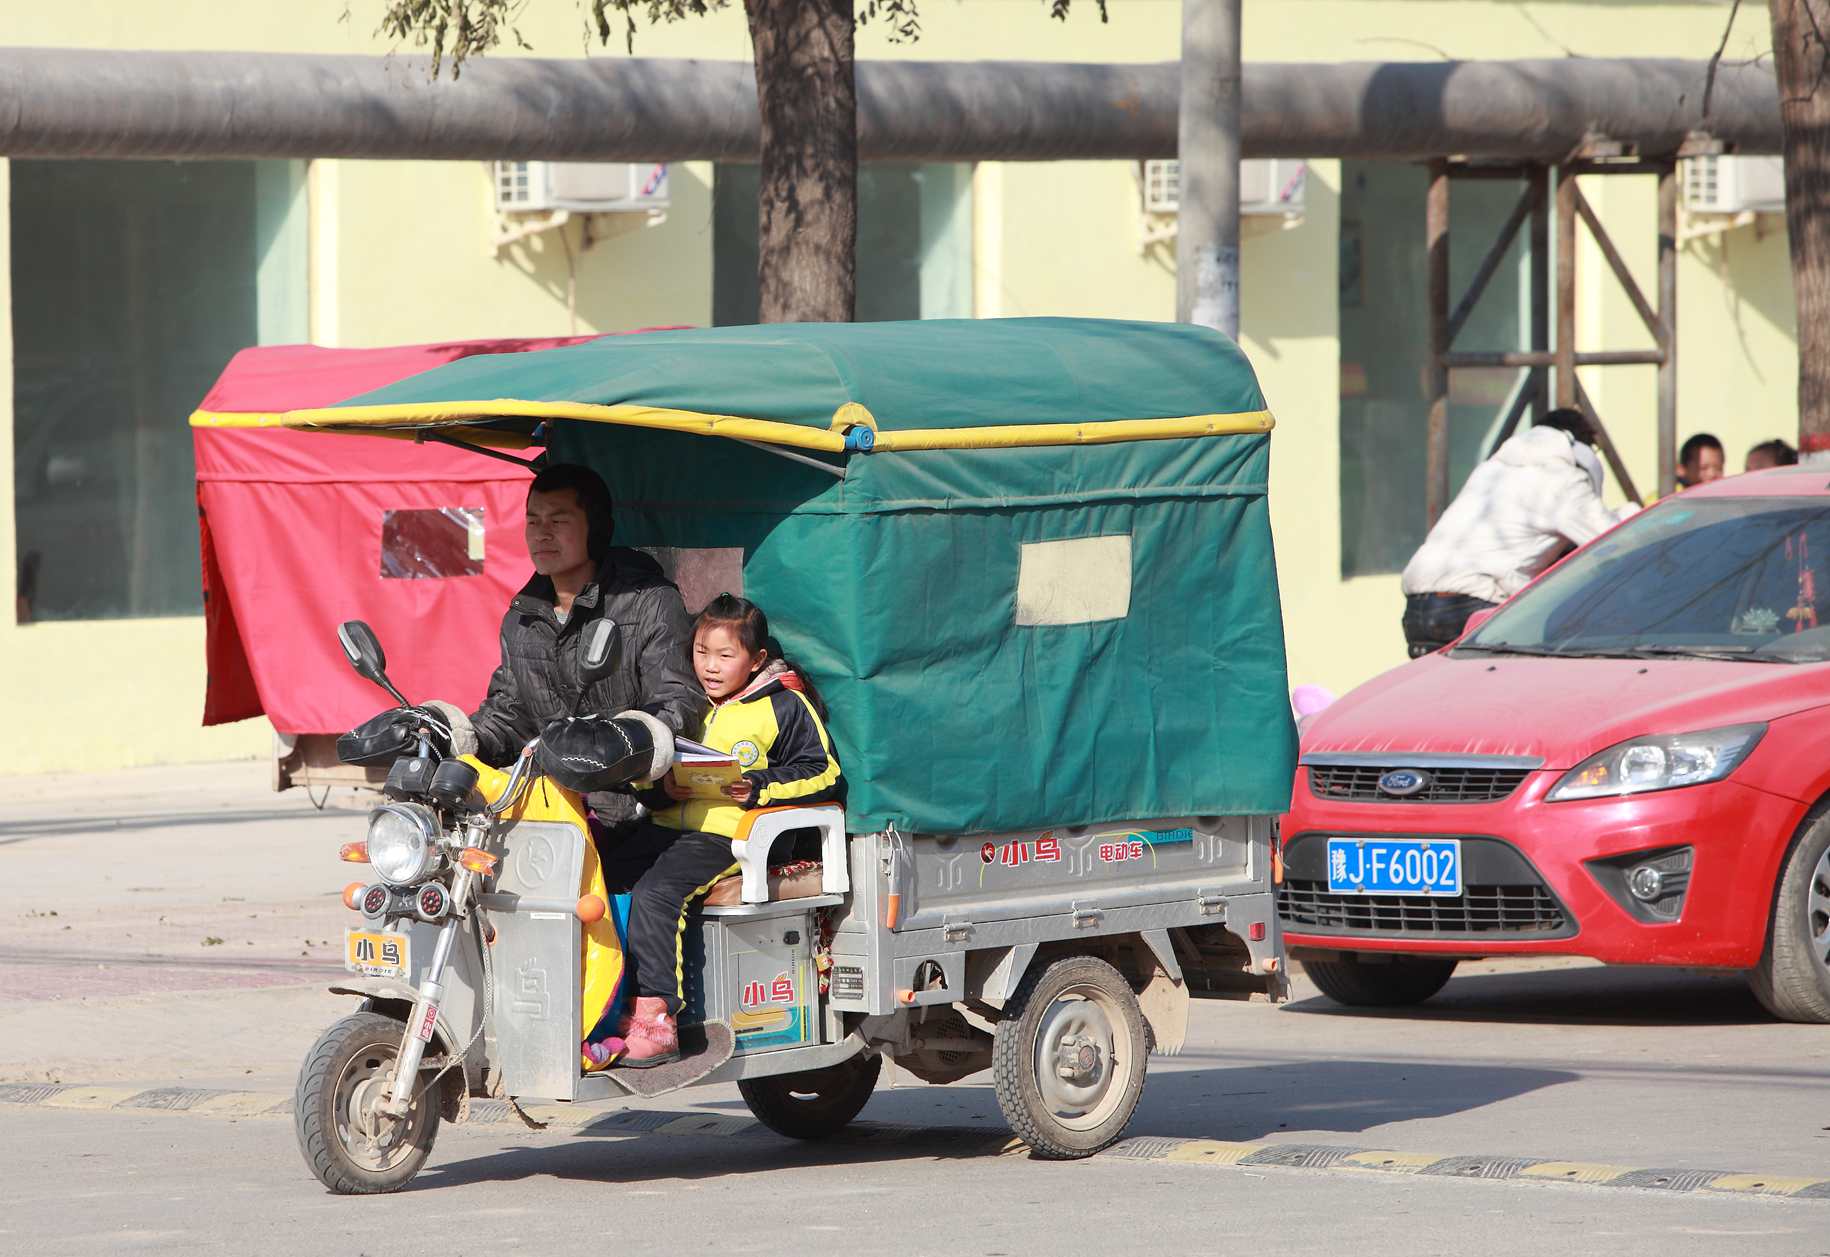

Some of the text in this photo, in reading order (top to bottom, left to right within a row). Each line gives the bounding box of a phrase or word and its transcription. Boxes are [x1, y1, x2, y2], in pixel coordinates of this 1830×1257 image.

[1000, 832, 1144, 868] 小鸟 电动车
[356, 938, 400, 965] 小鸟
[743, 971, 795, 1007] 小鸟
